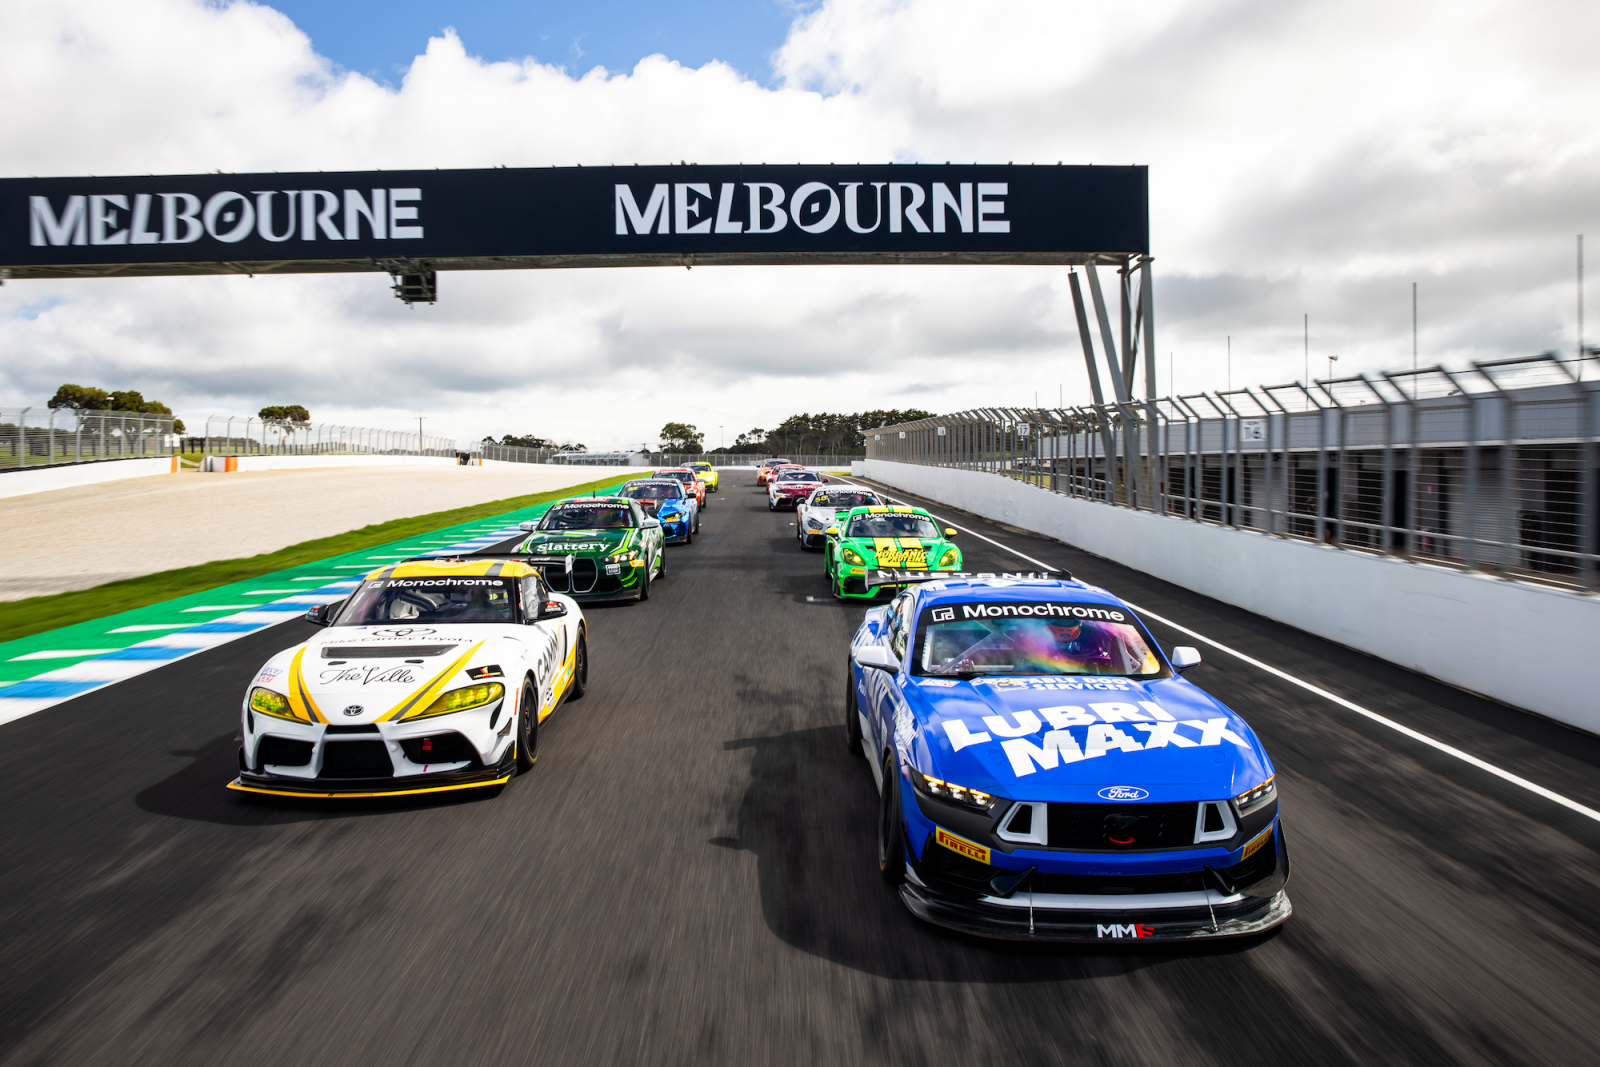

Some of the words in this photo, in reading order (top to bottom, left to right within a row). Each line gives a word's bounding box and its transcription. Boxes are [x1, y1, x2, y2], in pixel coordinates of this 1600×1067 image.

[614, 181, 1010, 235] MELBOURNE
[29, 187, 424, 246] MELBOURNE
[1019, 427, 1028, 435] 17
[1244, 426, 1262, 439] 16
[826, 489, 873, 497] Monochrome
[564, 502, 629, 510] Monochrome
[865, 512, 930, 521] Monochrome
[877, 570, 1049, 580] MUSTANG
[387, 578, 504, 588] Monochrome
[962, 603, 1125, 622] Monochrome
[320, 667, 362, 685] The
[362, 664, 424, 686] Ville
[1032, 683, 1130, 691] SERVICES
[941, 701, 1178, 752] LUBRI
[1000, 717, 1252, 778] MAXX
[1107, 787, 1140, 799] Ford
[938, 831, 987, 861] PIRELLI
[1244, 828, 1272, 858] PIRELLI
